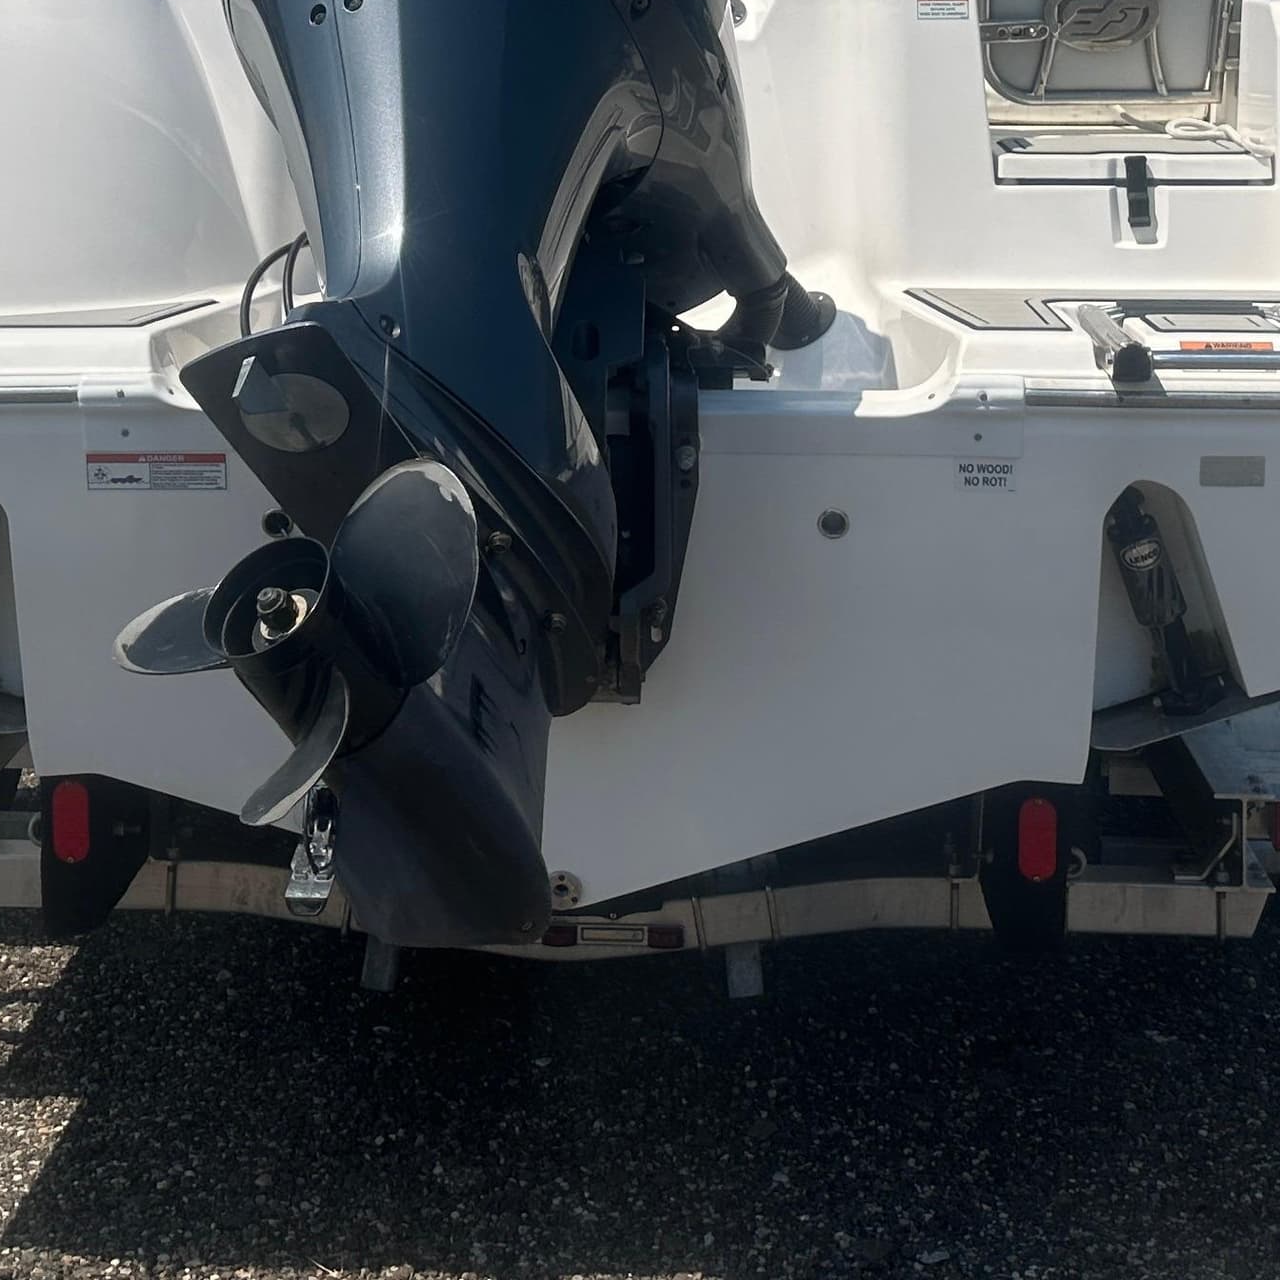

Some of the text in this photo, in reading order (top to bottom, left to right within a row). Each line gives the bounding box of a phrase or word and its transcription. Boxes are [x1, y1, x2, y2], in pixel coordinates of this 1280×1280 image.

[146, 454, 185, 463] DANGER
[958, 463, 974, 474] NO
[963, 475, 980, 487] NO
